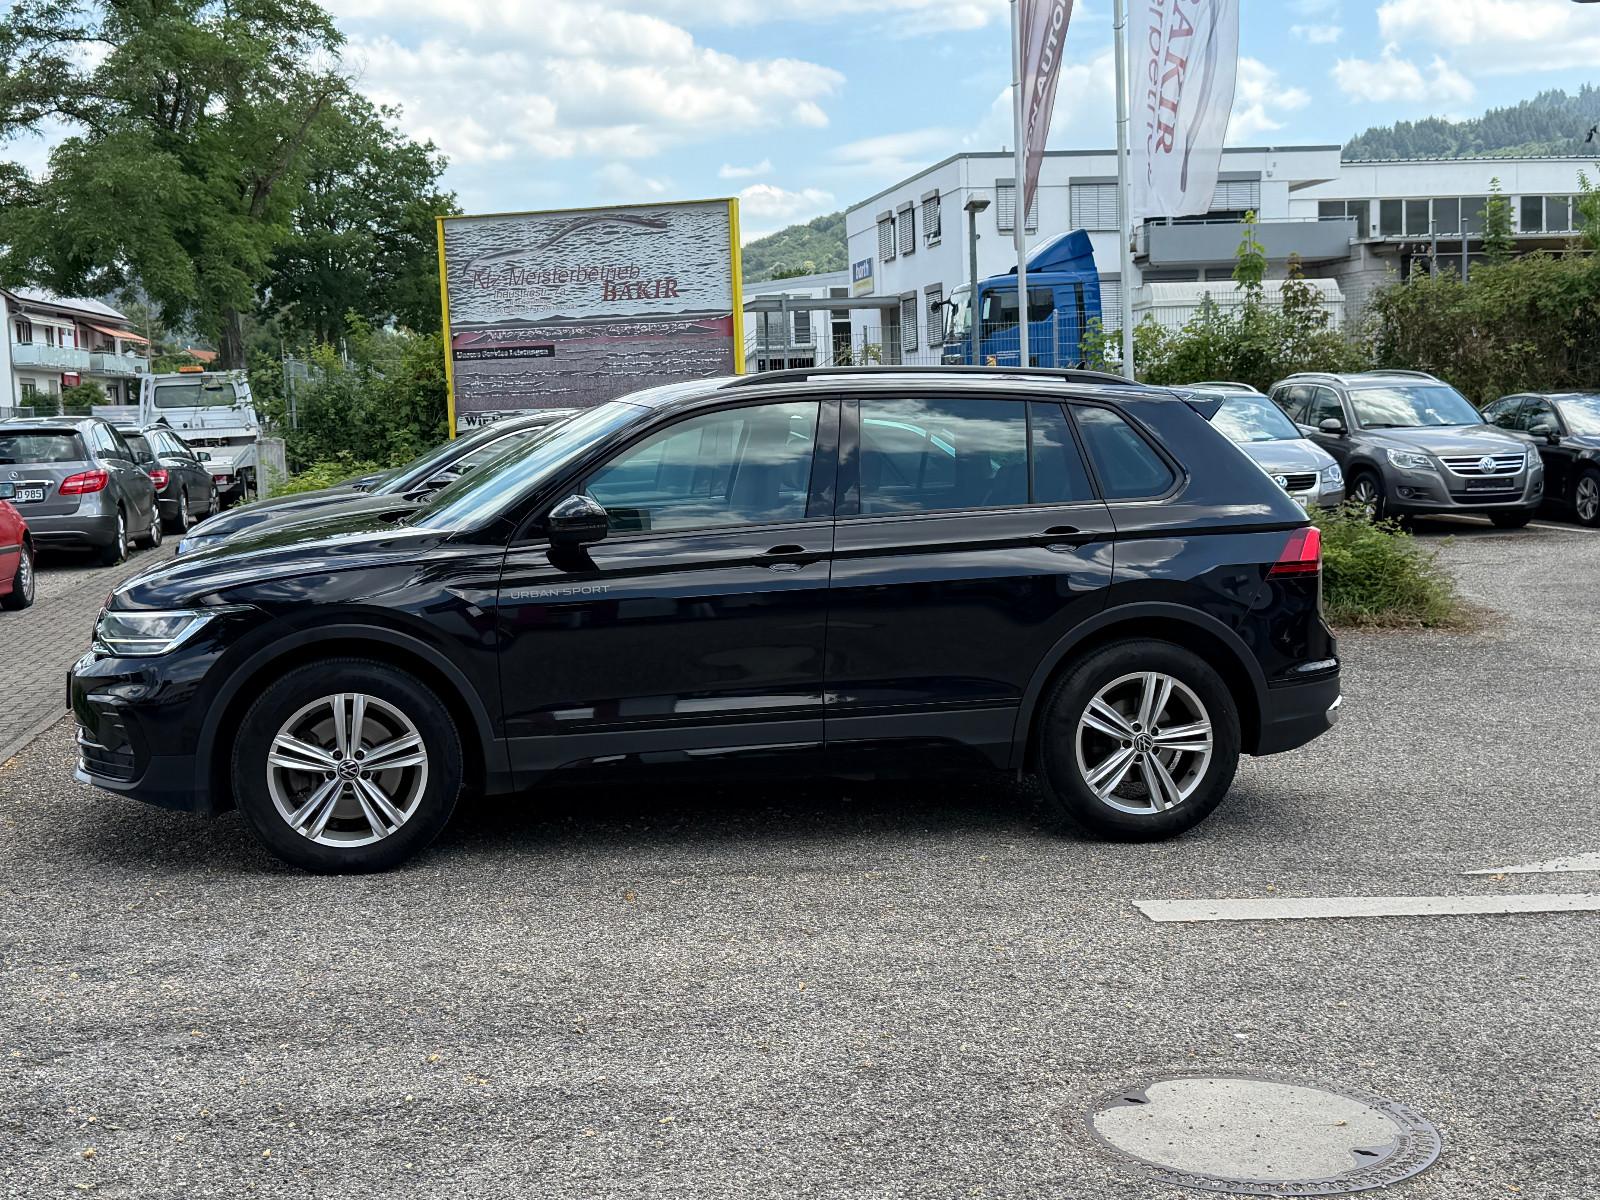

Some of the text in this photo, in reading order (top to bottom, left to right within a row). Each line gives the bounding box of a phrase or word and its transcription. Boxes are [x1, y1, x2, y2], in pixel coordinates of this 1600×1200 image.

[1155, 0, 1200, 154] AKIR
[602, 279, 680, 302] BAKIR
[24, 489, 42, 499] 985
[510, 585, 610, 600] URBAN SPORT
